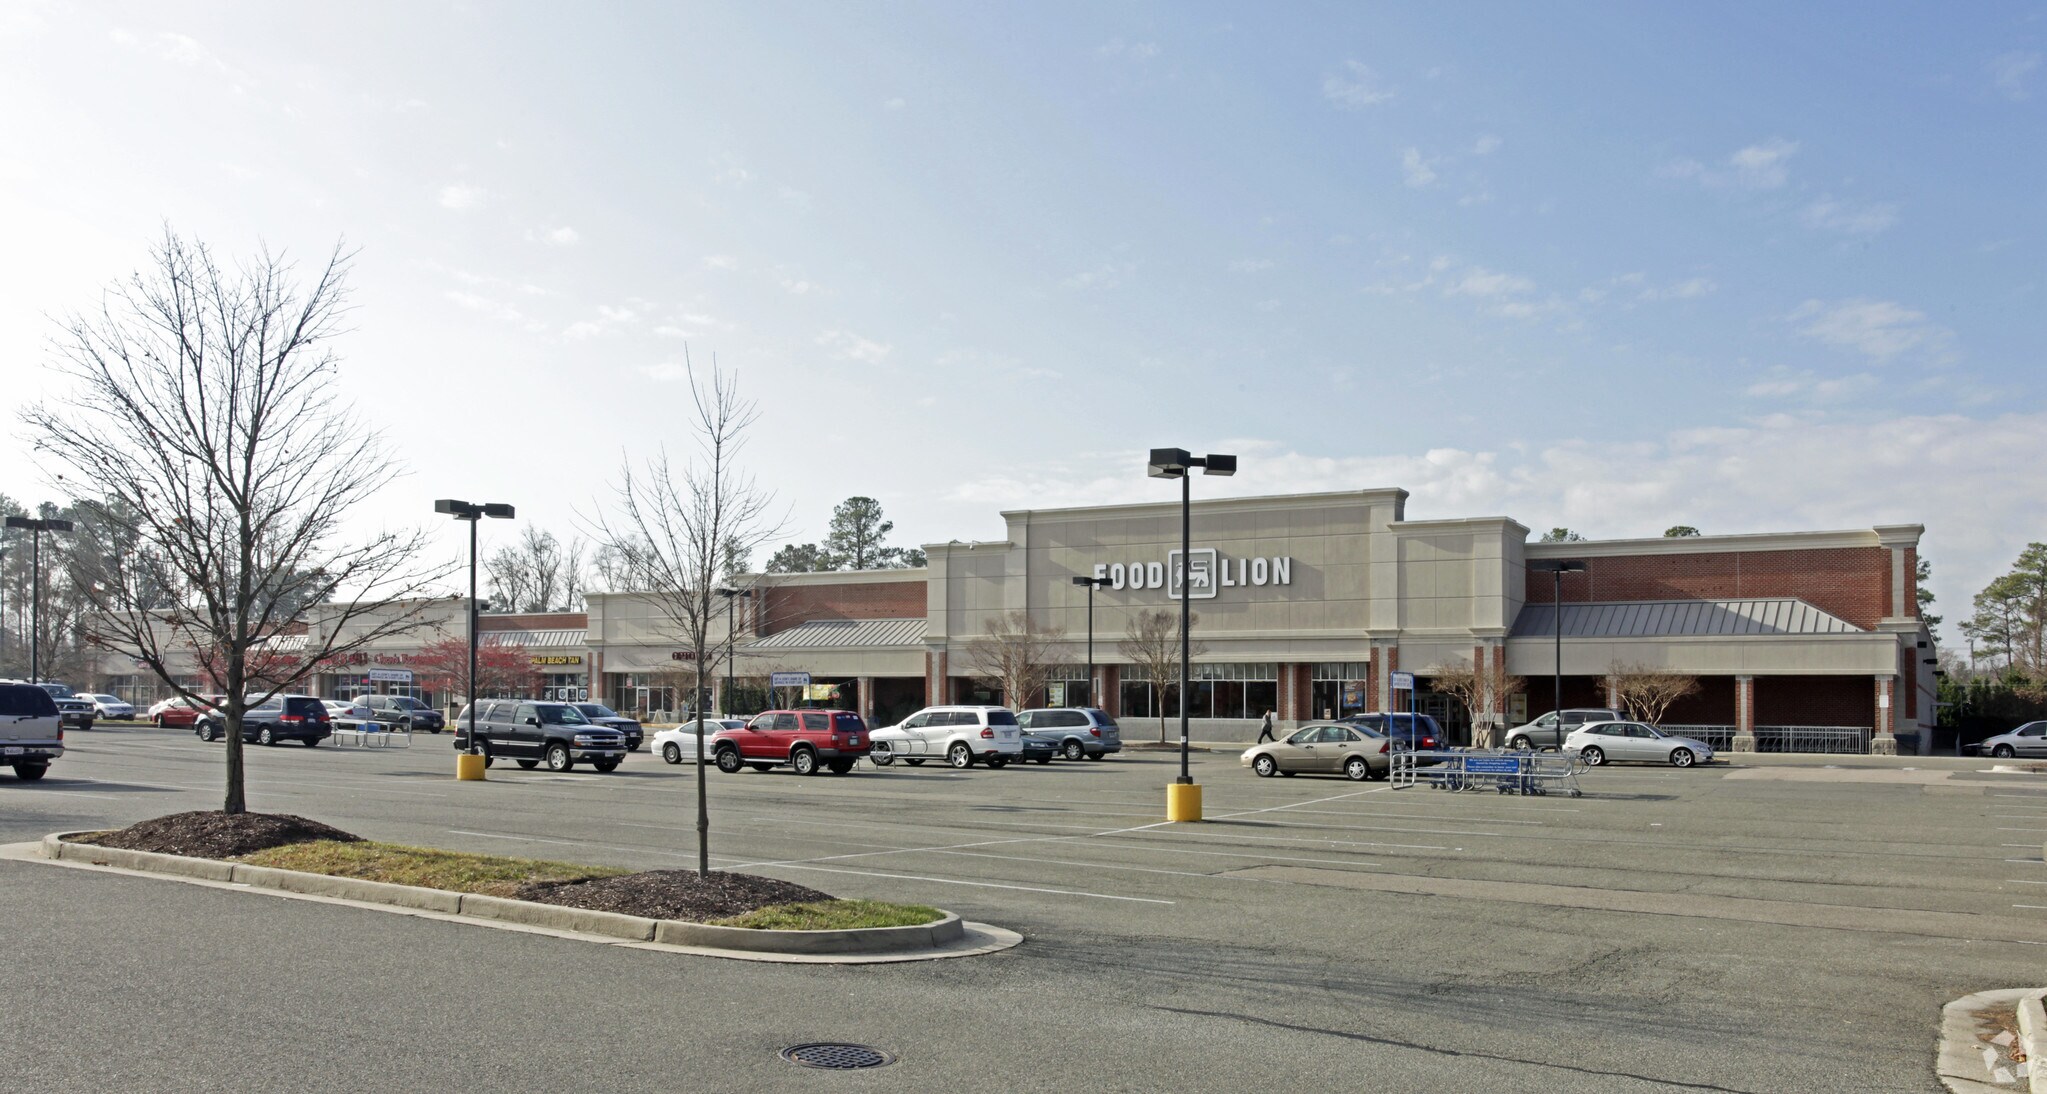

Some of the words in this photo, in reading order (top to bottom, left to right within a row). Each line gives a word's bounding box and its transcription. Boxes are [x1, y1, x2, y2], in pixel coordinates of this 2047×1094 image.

[1093, 562, 1164, 590] FOOD
[1221, 557, 1291, 587] LION
[531, 655, 546, 664] PALM
[547, 655, 567, 664] BEACH
[569, 655, 580, 664] TAN
